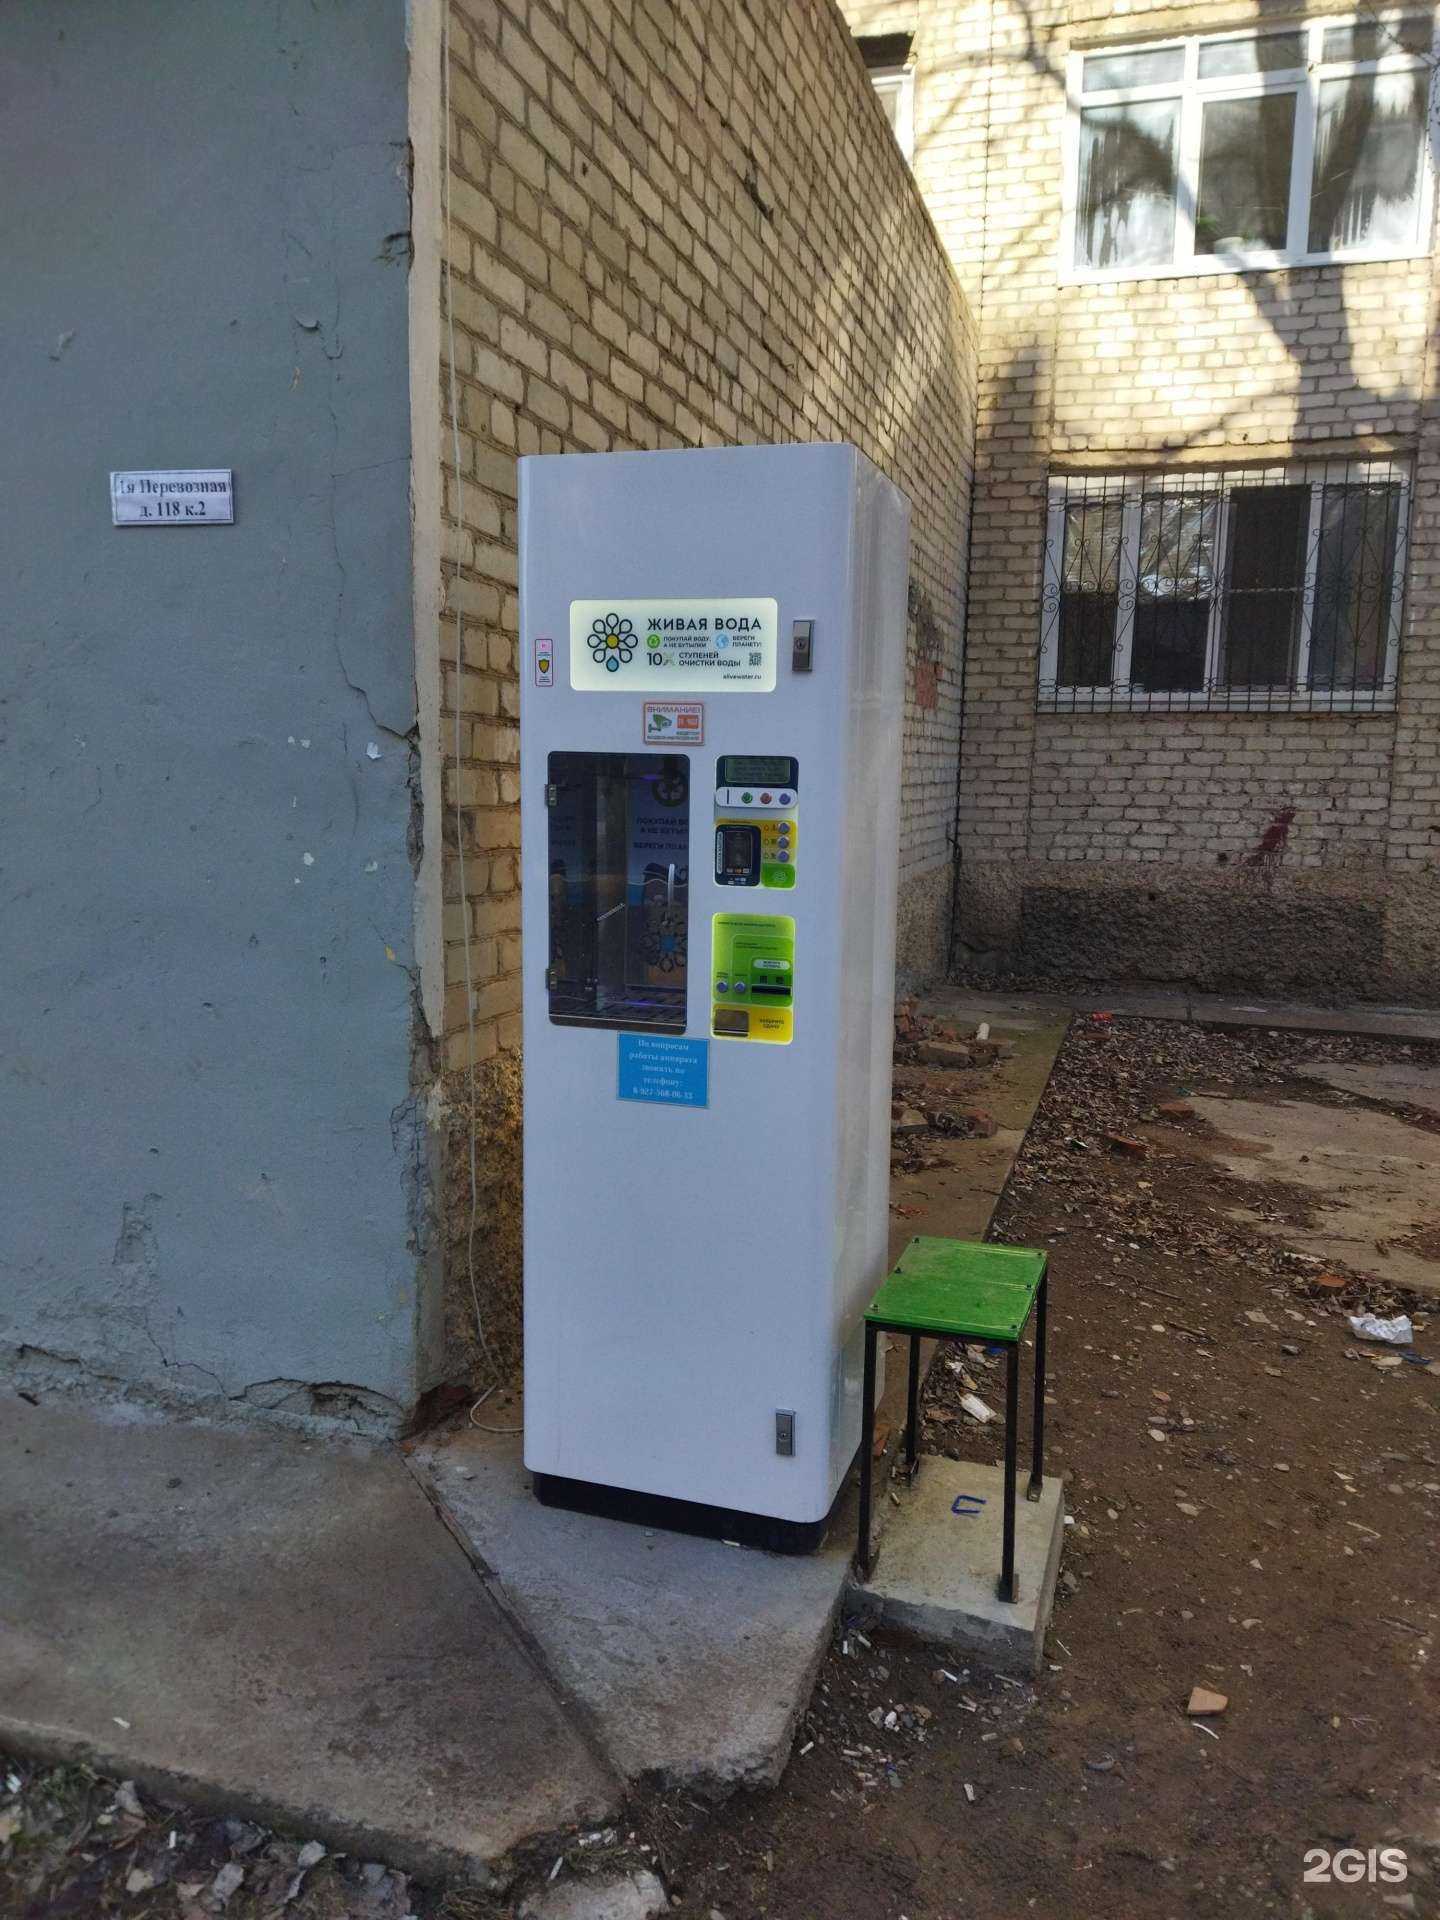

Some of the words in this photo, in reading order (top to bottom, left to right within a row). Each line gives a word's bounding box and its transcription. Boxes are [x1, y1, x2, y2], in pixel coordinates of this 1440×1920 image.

[140, 479, 227, 497] Перевозная
[157, 501, 180, 517] 118
[648, 617, 708, 631] ЖИВАЯ
[715, 617, 762, 632] ВОДА
[646, 652, 663, 666] 10
[679, 659, 716, 667] ОЧИСТКИ
